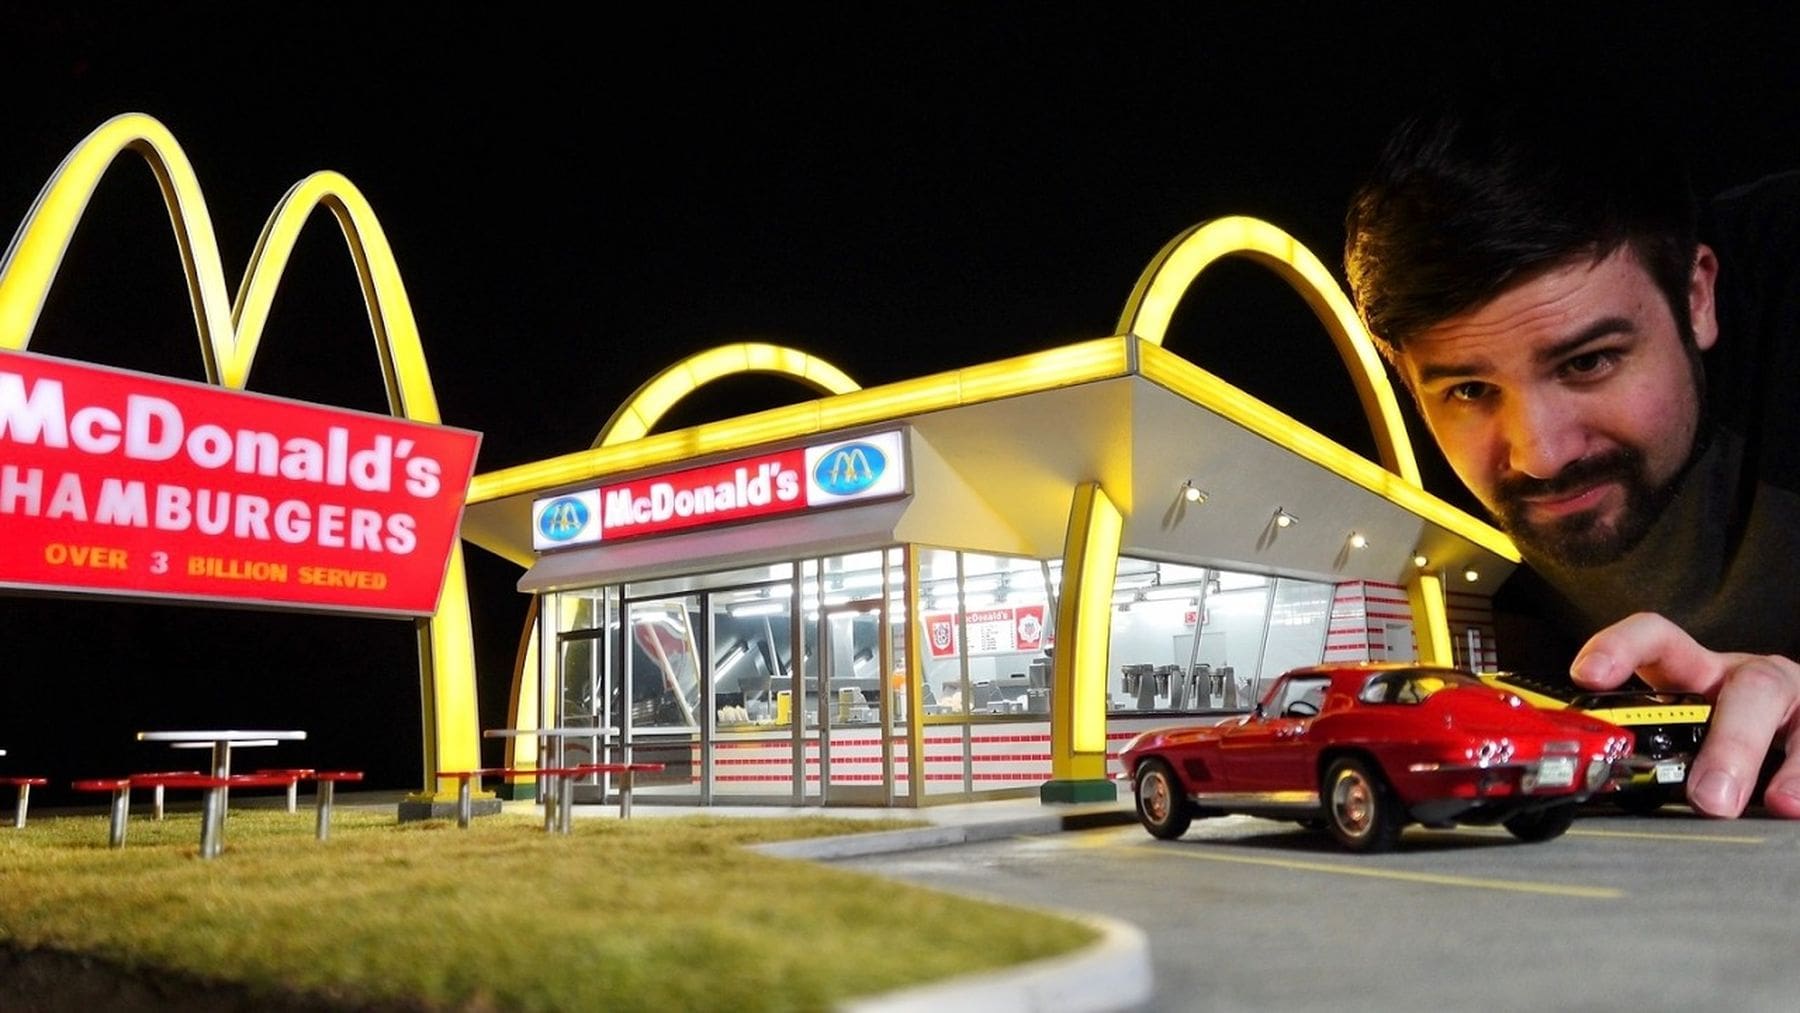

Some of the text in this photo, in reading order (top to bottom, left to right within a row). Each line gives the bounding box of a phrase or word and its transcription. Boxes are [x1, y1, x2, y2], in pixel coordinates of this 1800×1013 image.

[0, 371, 442, 499] McDonald's
[0, 464, 418, 555] HAMBURGERS
[603, 461, 800, 529] McDonald's
[44, 543, 388, 591] OVER 3 BILLION SERVED
[965, 610, 1009, 624] cDonald's
